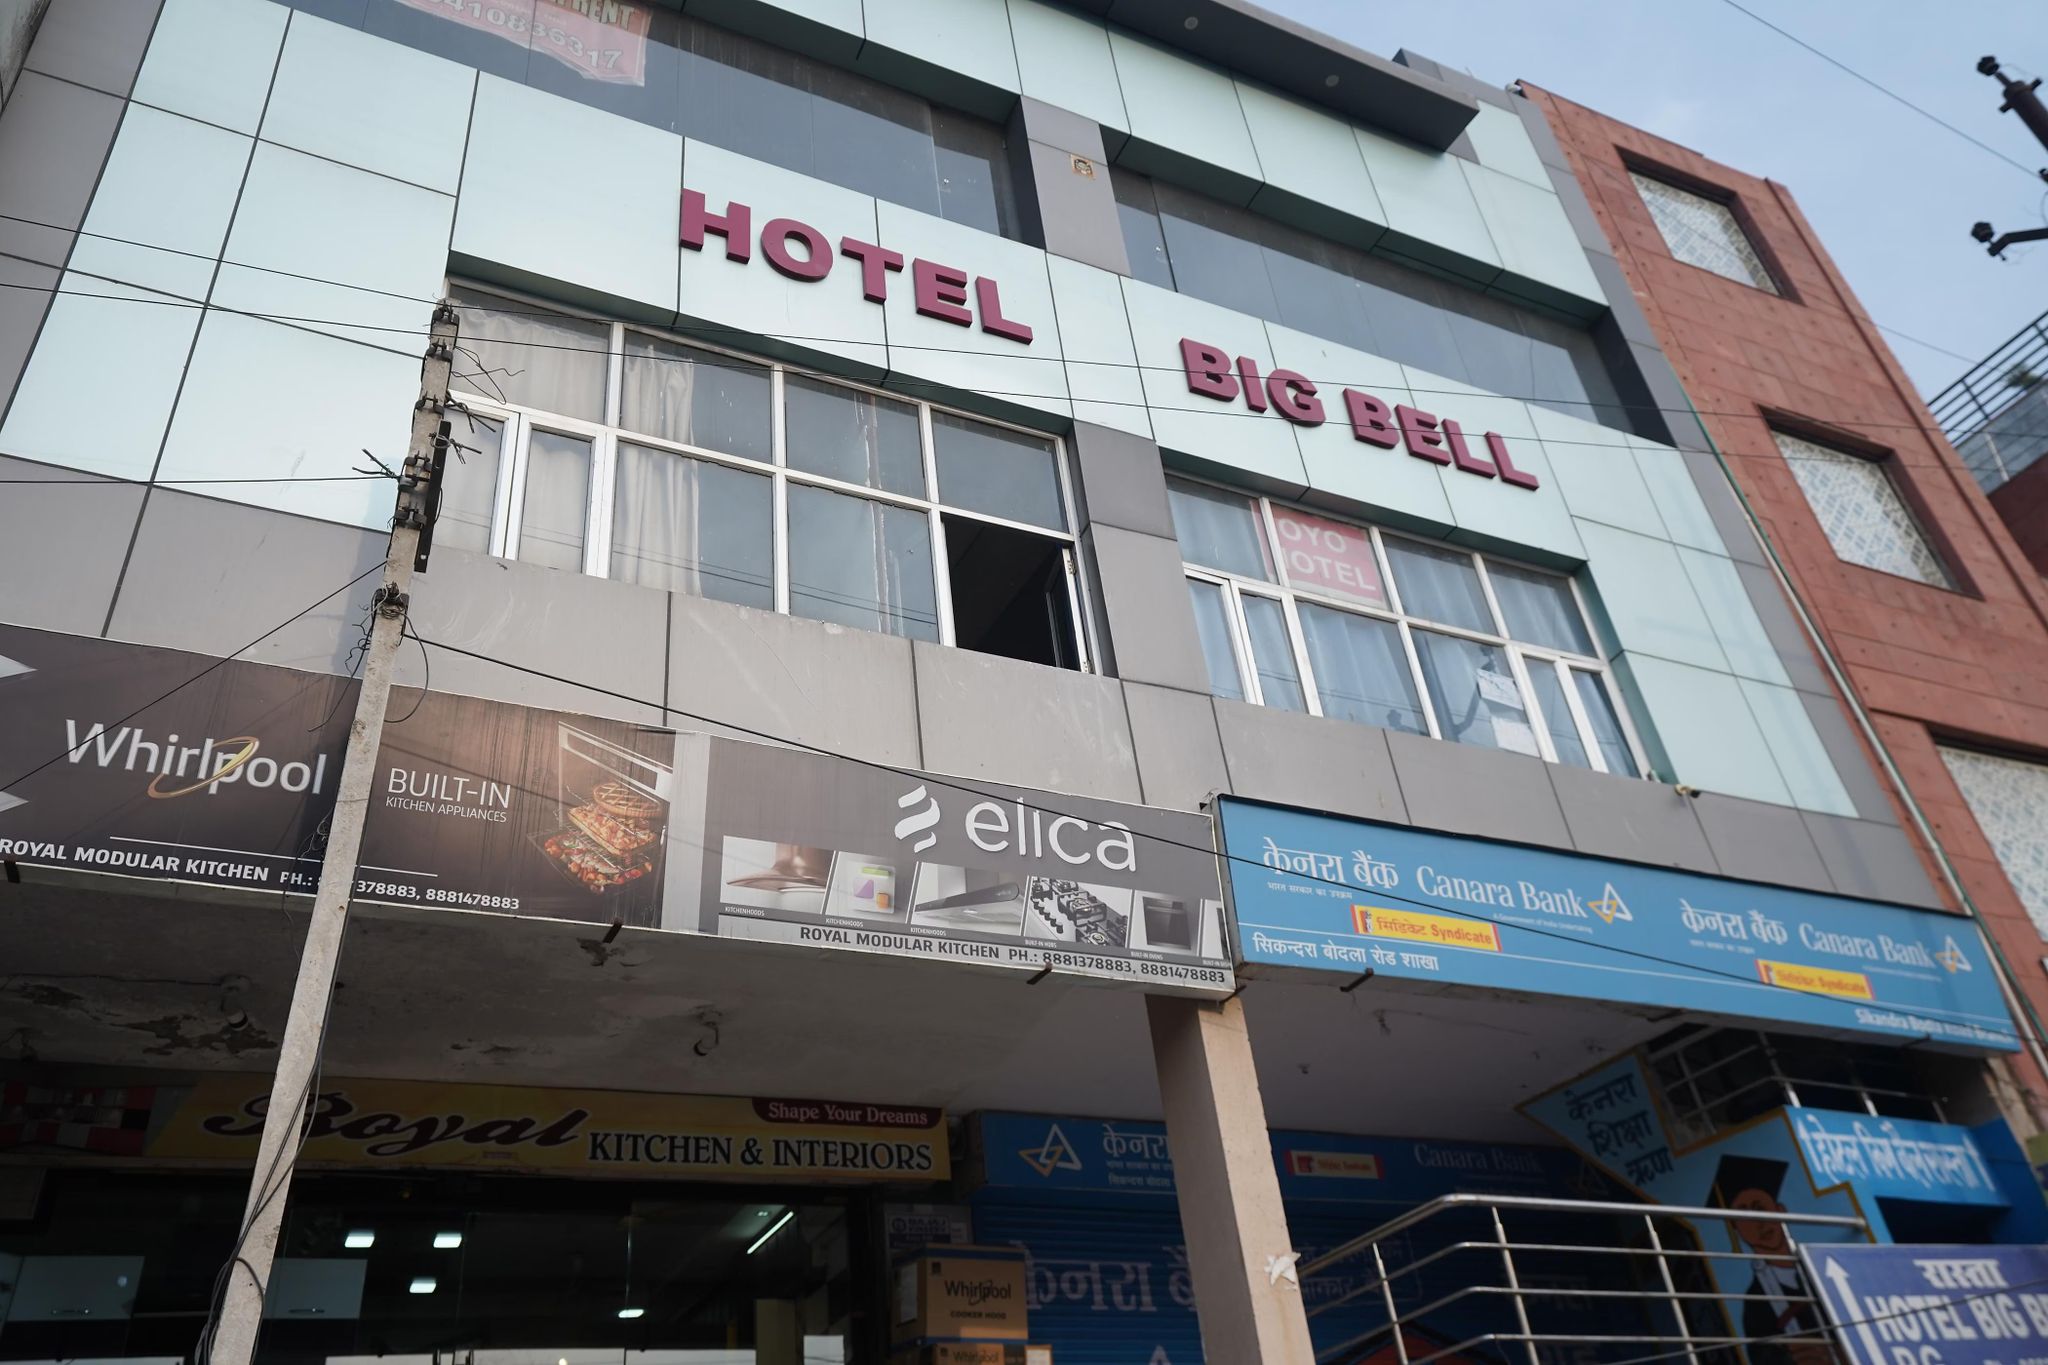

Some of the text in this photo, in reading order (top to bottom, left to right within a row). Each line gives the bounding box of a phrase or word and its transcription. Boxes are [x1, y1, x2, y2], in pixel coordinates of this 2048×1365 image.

[426, 0, 623, 70] 410836317
[680, 187, 1034, 345] HOTEL
[1179, 337, 1539, 491] BIG BELL
[1278, 519, 1347, 553] OYO
[65, 719, 328, 795] Whirlpool
[385, 796, 507, 823] KITCHEN APPLIANCES
[387, 767, 511, 808] BUILT-IN
[965, 797, 1136, 872] elica
[0, 838, 67, 860] ROYAL
[74, 846, 180, 872] MODULAR
[186, 859, 269, 882] KITCHEN
[426, 887, 520, 910] 8881478883
[1263, 836, 1400, 889] केनरा बैंक
[1416, 865, 1589, 919] Canara Bank
[1431, 925, 1492, 945] Syndicate
[1680, 898, 1748, 941] केनरा
[800, 926, 851, 944] ROYAL
[856, 932, 933, 952] MODULAR
[938, 941, 1000, 960] KITCHEN
[1042, 951, 1137, 975] 8881378883,
[1140, 963, 1226, 983] 8881478883
[1252, 931, 1440, 971] सिकन्दरा बोदला रोड शाखा
[1798, 922, 1878, 960] Canara
[1878, 934, 1937, 969] Bank
[203, 1090, 588, 1156] Royal
[768, 1101, 928, 1125] Shape Your Dreams
[1587, 1109, 1653, 1157] शिक्षा
[588, 1131, 933, 1171] KITCHEN & INTERIORS
[1413, 1143, 1544, 1174] Canara Bank
[945, 1280, 1011, 1302] Whirlpool
[1913, 1258, 2009, 1289] रास्ता
[950, 1310, 982, 1319] COOKER
[1864, 1295, 1979, 1343] HOTEL
[1966, 1293, 2030, 1339] BIG
